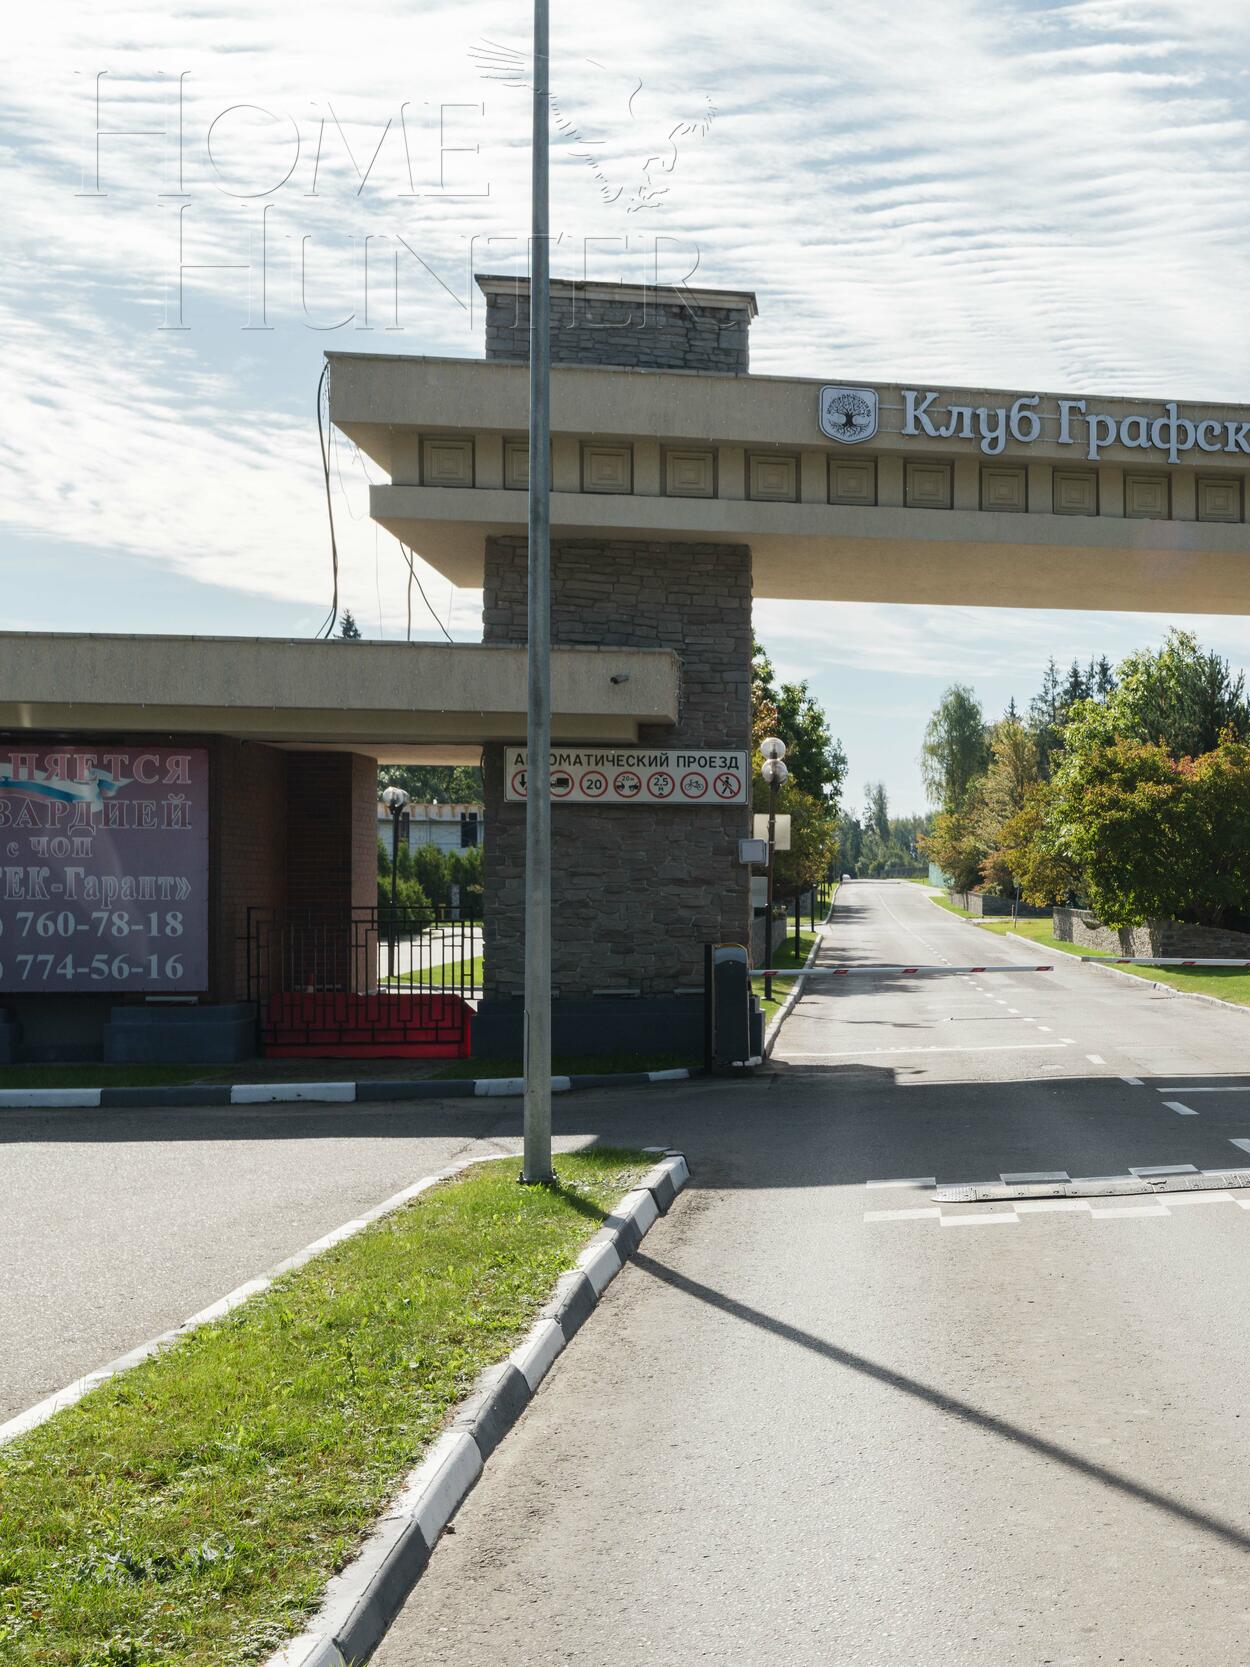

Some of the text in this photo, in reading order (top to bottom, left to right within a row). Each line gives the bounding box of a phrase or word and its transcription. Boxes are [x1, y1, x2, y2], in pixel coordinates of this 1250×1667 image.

[901, 390, 1041, 455] Клуб
[0, 752, 192, 784] НЯЕТСЯ
[514, 752, 740, 770] АОМАТИЧЕСКИЙ ПРОЕЗД
[586, 778, 602, 791] 20
[29, 837, 93, 858] ЧОП
[0, 866, 192, 909] ЕК-Гарант»
[16, 911, 184, 937] 760-78-18
[16, 953, 184, 979] 774-56-16
